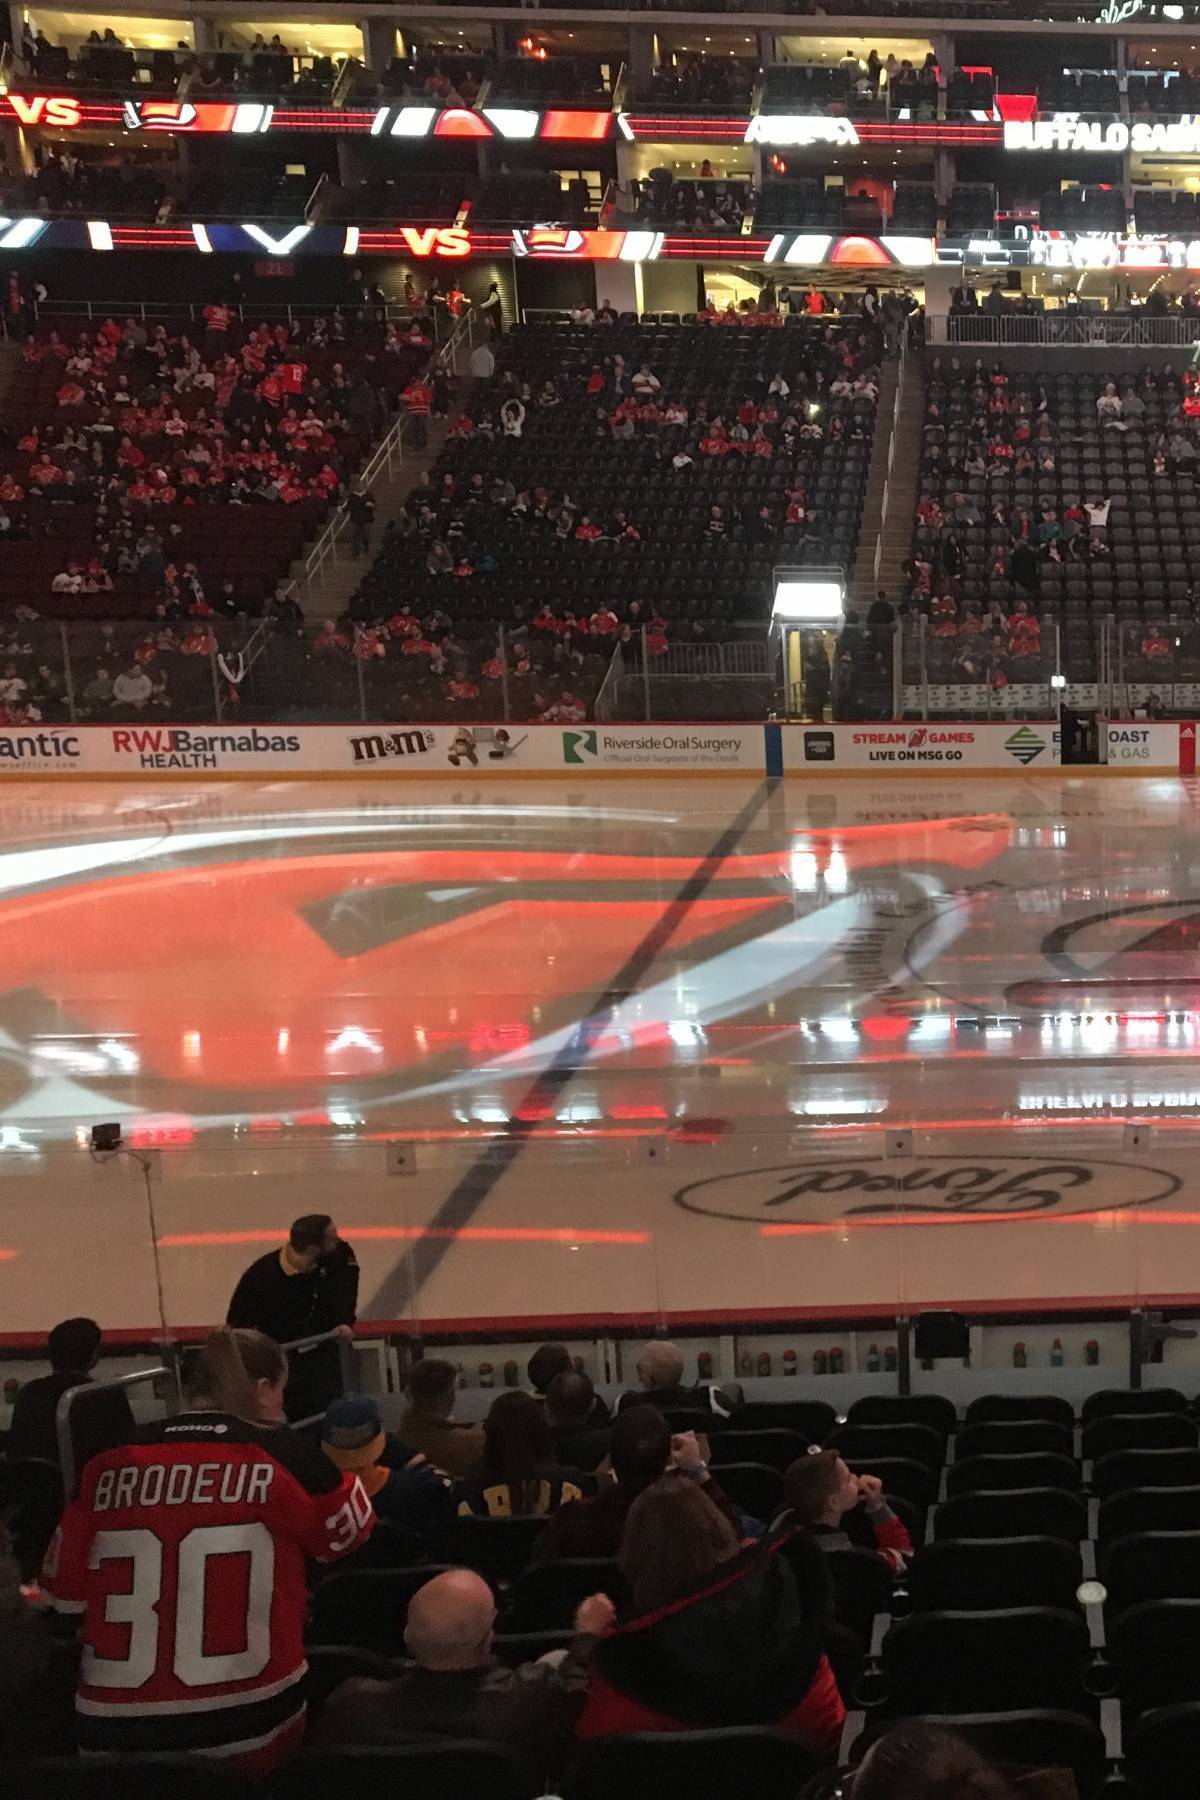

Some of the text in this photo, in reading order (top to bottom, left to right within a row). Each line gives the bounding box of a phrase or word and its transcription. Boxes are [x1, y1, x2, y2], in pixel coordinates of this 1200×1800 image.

[7, 96, 81, 126] VS
[1003, 121, 1128, 150] BUFFALO
[401, 227, 471, 255] VS
[603, 737, 741, 752] Riverside Oral Surgery
[853, 732, 975, 744] STREAM GAMES
[1109, 731, 1149, 743] OAST
[140, 754, 217, 768] HEALTH
[869, 750, 962, 760] LIVE ON MSG GO
[1121, 748, 1150, 759] GAS
[763, 1165, 1093, 1215] Ford
[93, 1463, 274, 1512] BRODEUR
[325, 1480, 373, 1552] 30
[80, 1522, 275, 1689] 30
